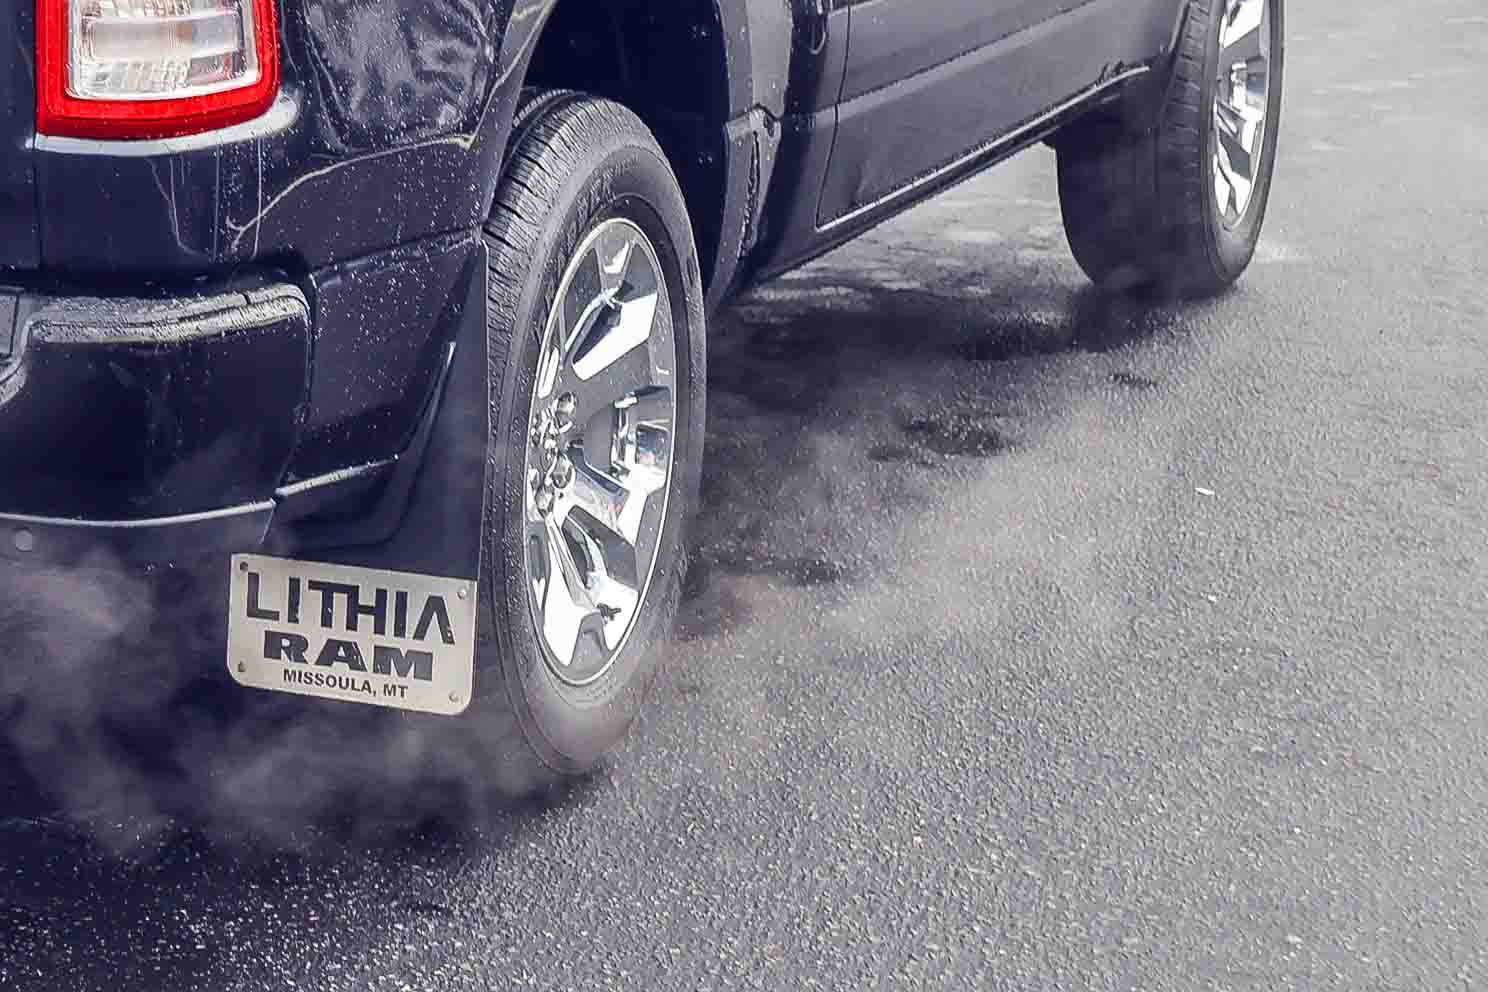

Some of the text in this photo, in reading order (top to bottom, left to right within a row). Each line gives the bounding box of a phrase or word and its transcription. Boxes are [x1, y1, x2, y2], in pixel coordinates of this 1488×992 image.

[247, 571, 456, 646] LITHIA
[264, 629, 433, 682] RAM
[283, 668, 409, 699] MISSOULA, MT
